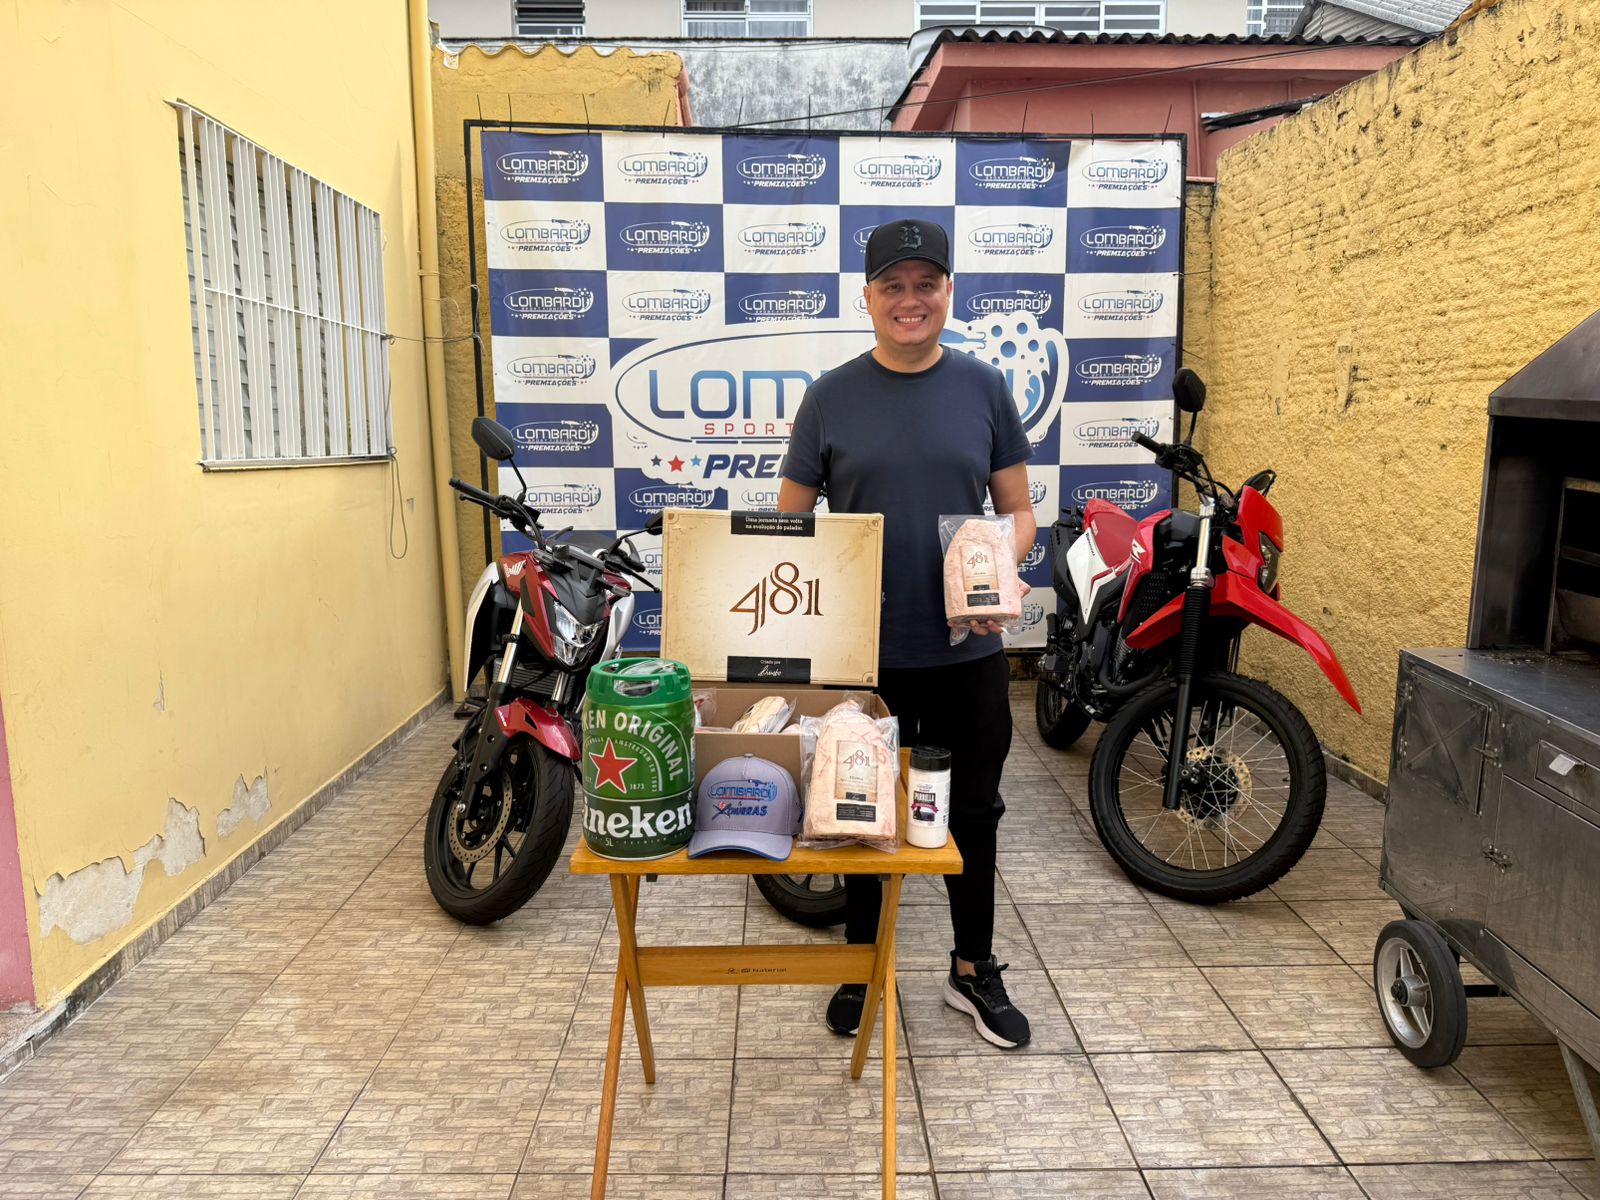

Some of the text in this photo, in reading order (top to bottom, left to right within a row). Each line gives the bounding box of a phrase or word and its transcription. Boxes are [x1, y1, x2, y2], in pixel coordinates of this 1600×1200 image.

[502, 158, 579, 171] LOMBARDI
[624, 160, 699, 173] LOMBARDI
[742, 162, 817, 175] LOMBARDI
[860, 163, 933, 176] LOMBARDI
[976, 164, 1047, 178] LOMBARDI
[1087, 166, 1159, 179] LOMBARDI
[514, 176, 569, 184] PREMIAÇÕES
[635, 177, 688, 185] PREMIAÇÕES
[870, 181, 922, 189] PREMIAÇÕES
[1098, 183, 1147, 191] PREMIAÇÕES
[506, 227, 582, 240] LOMBARDI
[626, 230, 700, 242] LOMBARDI
[743, 230, 817, 242] LOMBARDI
[974, 231, 1046, 244] LOMBARDI
[1086, 233, 1158, 245] LOMBARDI
[519, 244, 571, 252] PREMIAÇÕES
[984, 247, 1035, 255] PREMIAÇÕES
[1097, 249, 1146, 257] PREMIAÇÕES
[510, 296, 584, 308] LOMBARDI
[628, 297, 701, 309] LOMBARDI
[745, 299, 817, 311] LOMBARDI
[972, 298, 1043, 310] LOMBARDI
[1083, 298, 1155, 310] LOMBARDI
[513, 362, 587, 374] LOMBARDI
[1081, 363, 1153, 376] LOMBARDI
[516, 428, 592, 441] LOMBARDI
[704, 423, 795, 435] SPORT
[1079, 426, 1150, 438] LOMBARDI
[524, 492, 593, 504] OMBARDI
[634, 492, 706, 504] LOMBARDI
[1077, 488, 1148, 500] LOMBARDI
[614, 712, 683, 781] ORIGINAL
[583, 795, 693, 840] ineken
[605, 838, 613, 847] 5L
